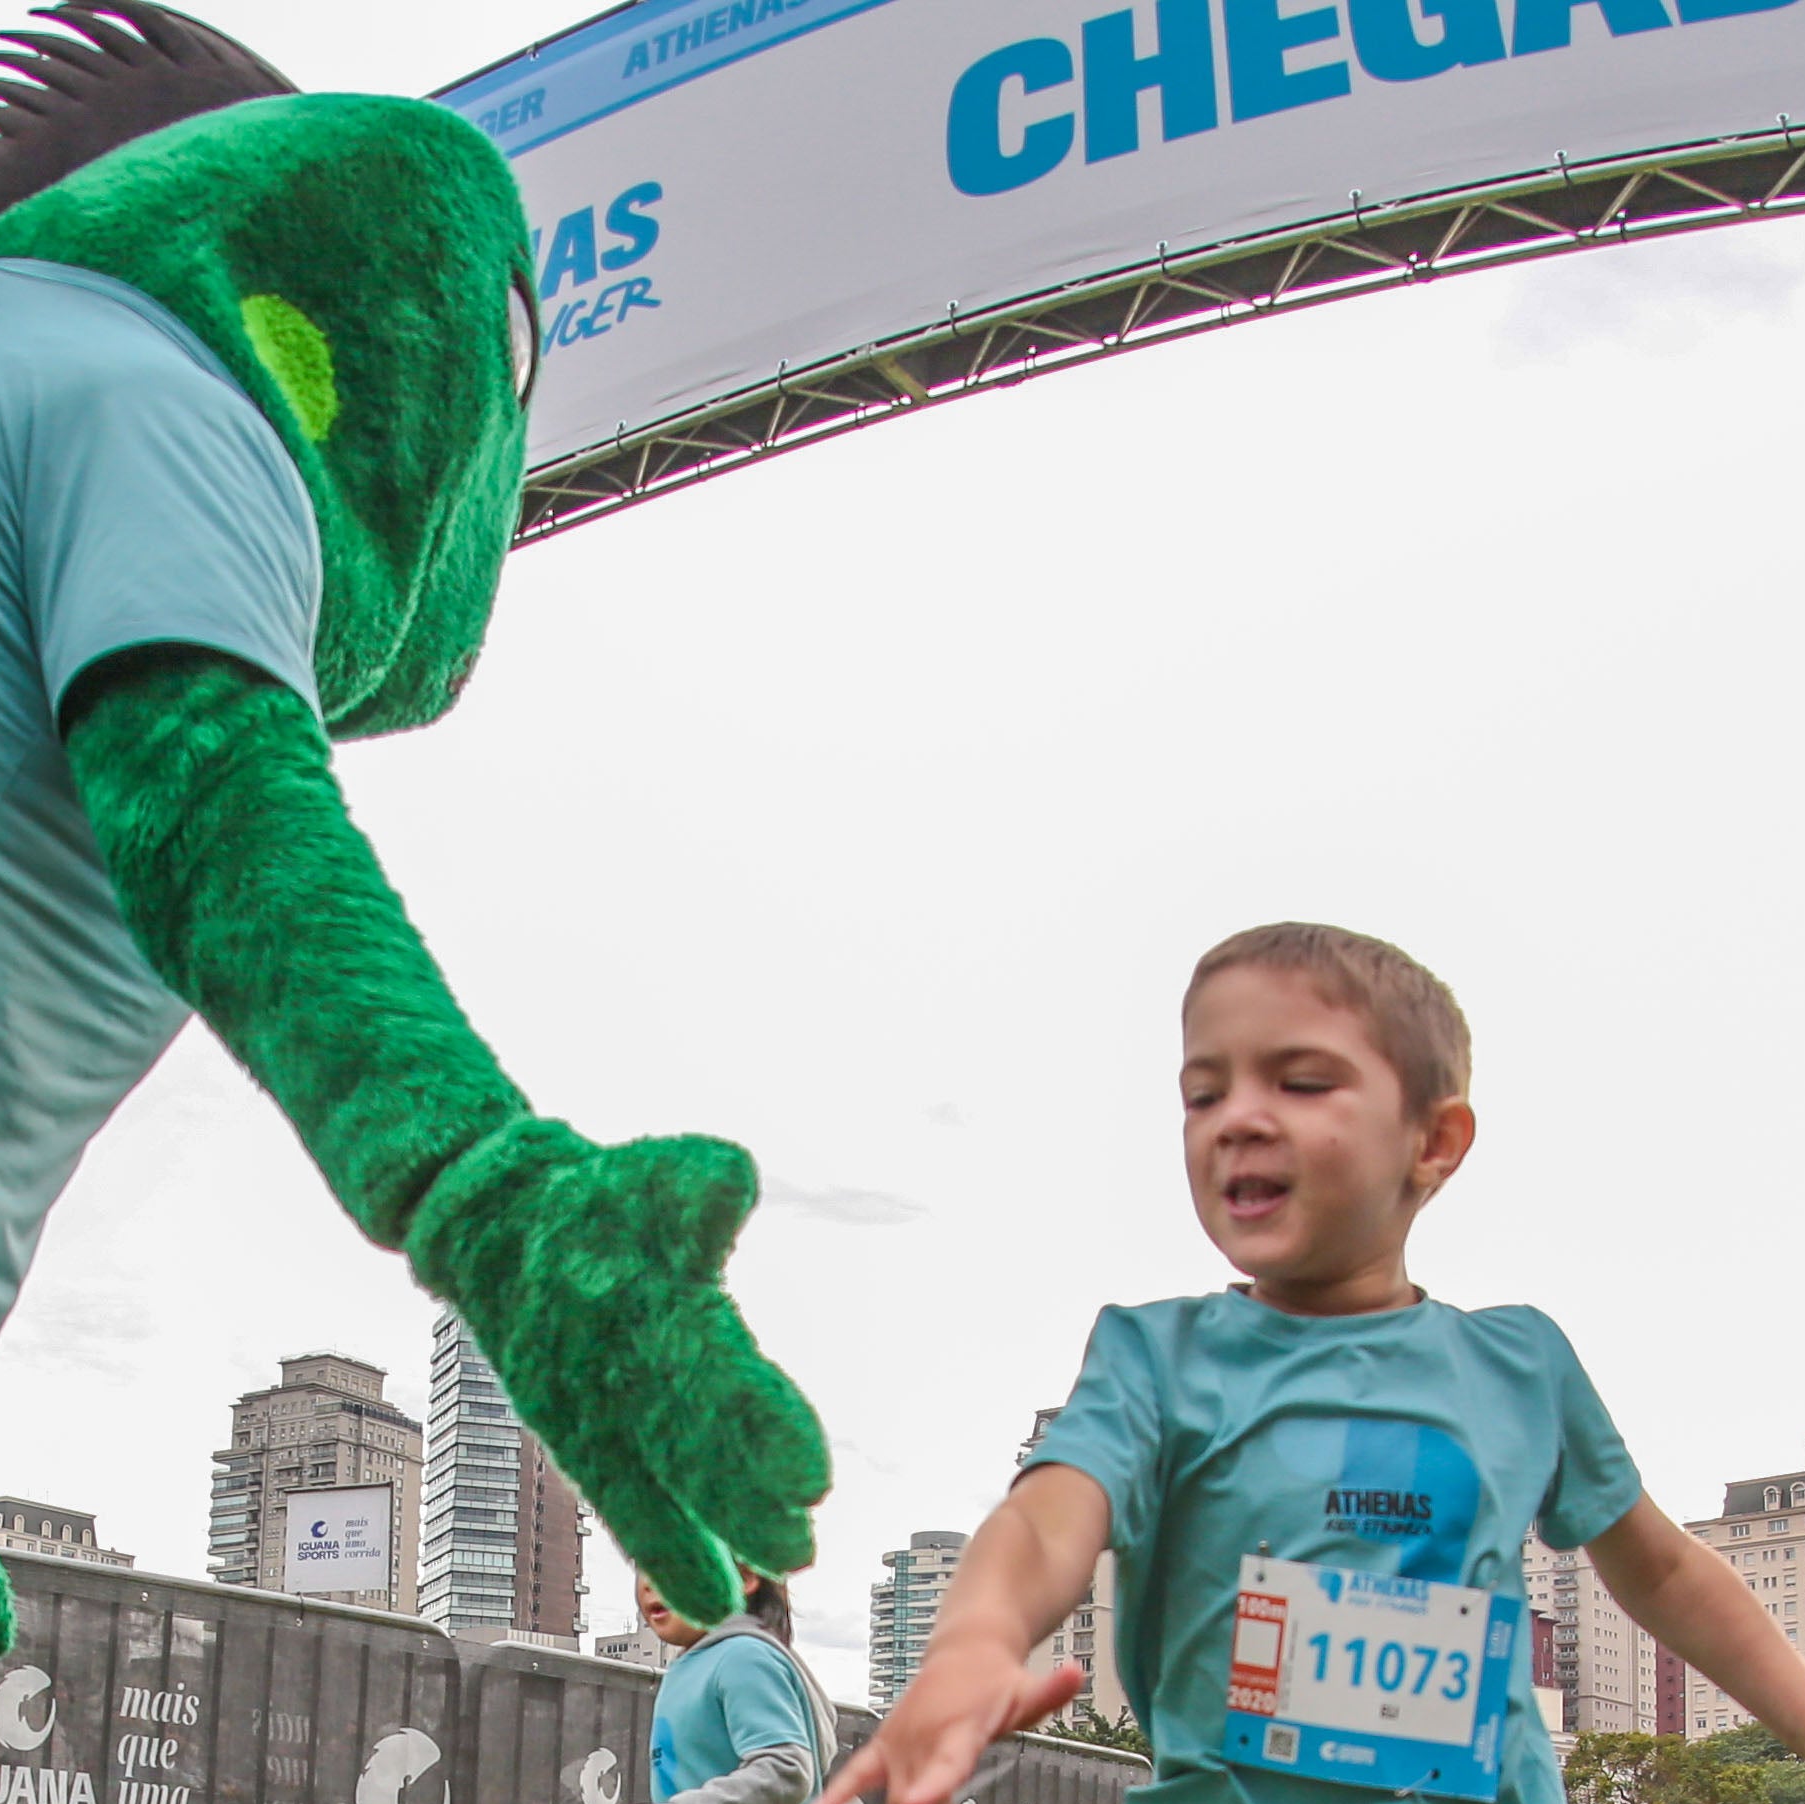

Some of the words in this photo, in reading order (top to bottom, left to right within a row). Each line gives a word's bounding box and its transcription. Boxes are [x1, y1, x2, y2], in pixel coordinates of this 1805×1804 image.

[622, 0, 810, 80] ATHENA
[1325, 1489, 1433, 1519] ATHENAS
[297, 1550, 340, 1561] SPORTS
[298, 1541, 340, 1551] IGUANA
[344, 1547, 381, 1558] corrida
[1307, 1632, 1471, 1701] 11073
[118, 1682, 200, 1726] mais
[117, 1733, 179, 1778] que
